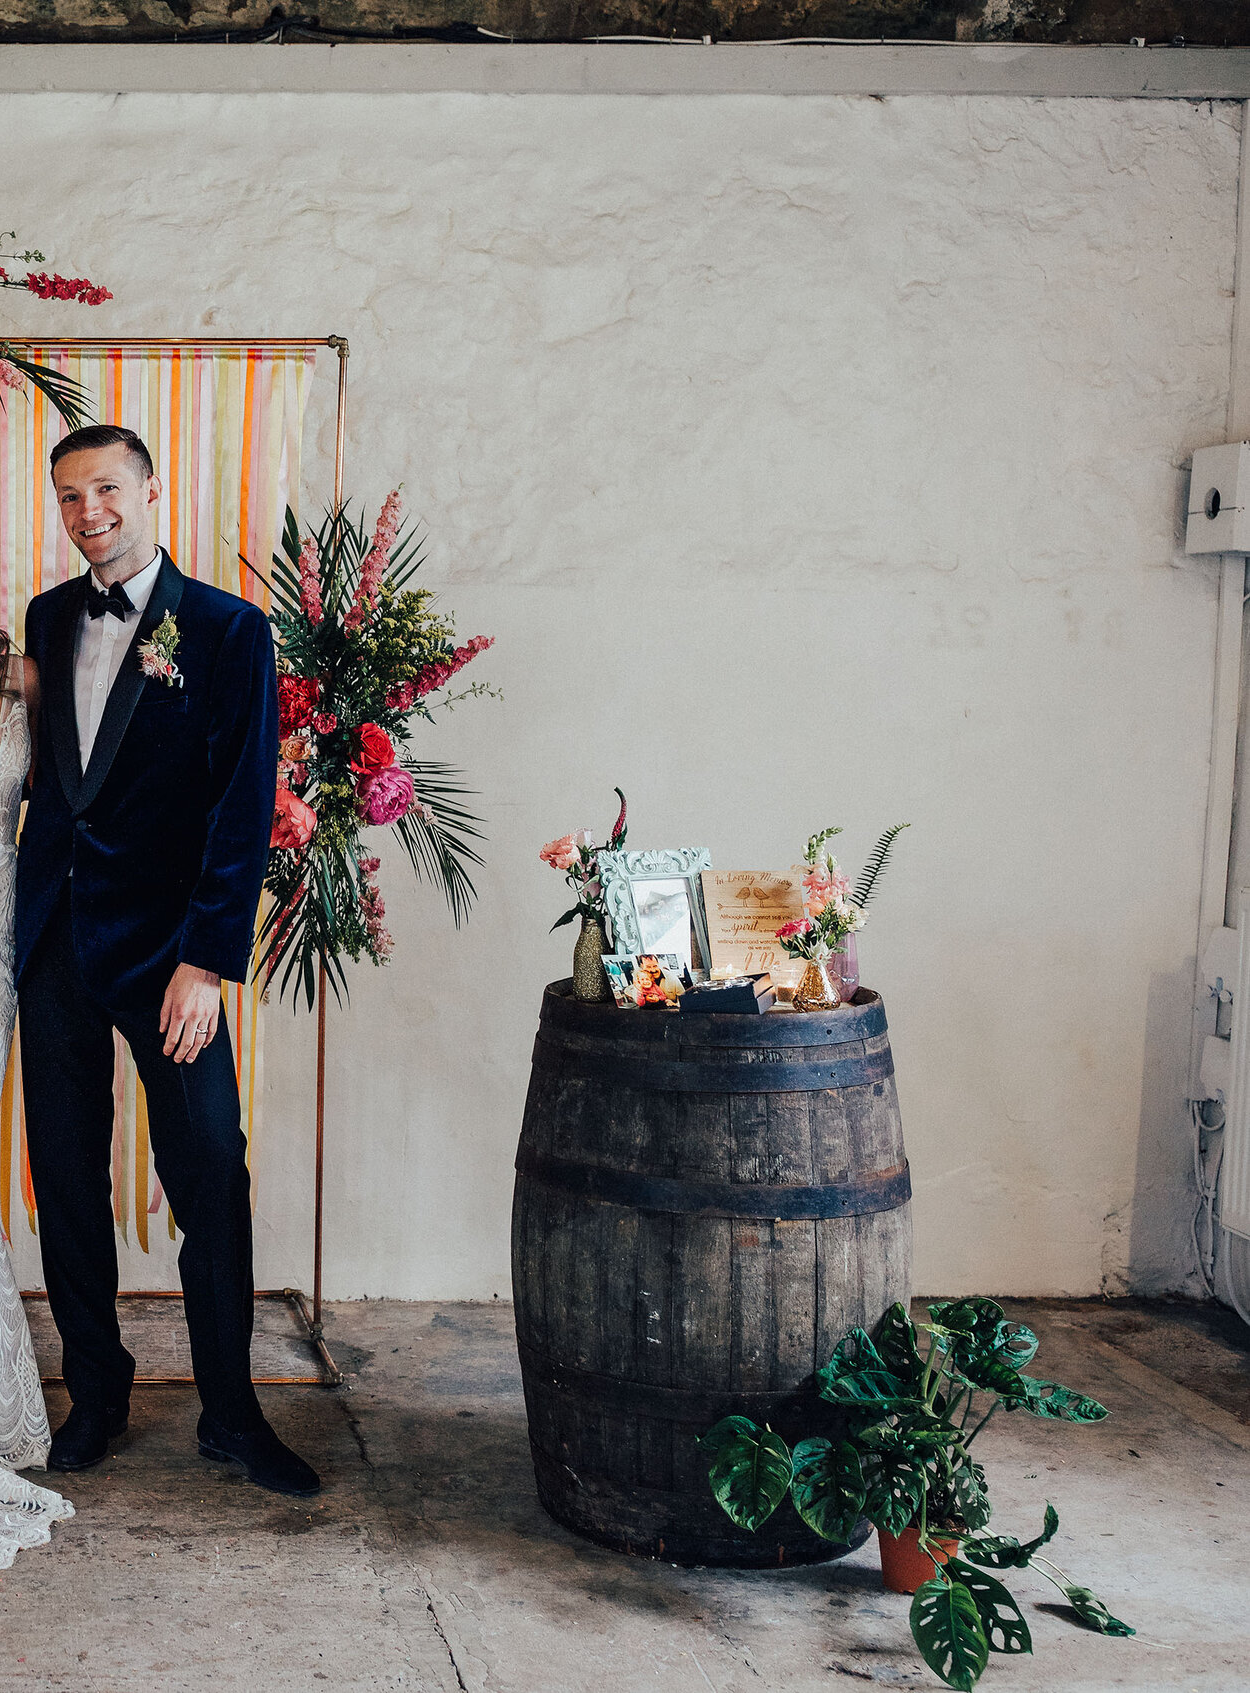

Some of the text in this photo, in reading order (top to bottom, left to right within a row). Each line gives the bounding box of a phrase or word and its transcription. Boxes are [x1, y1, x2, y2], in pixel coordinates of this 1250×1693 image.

[715, 871, 792, 891] In Loving Memory
[731, 920, 759, 936] spirit
[744, 951, 753, 971] I
